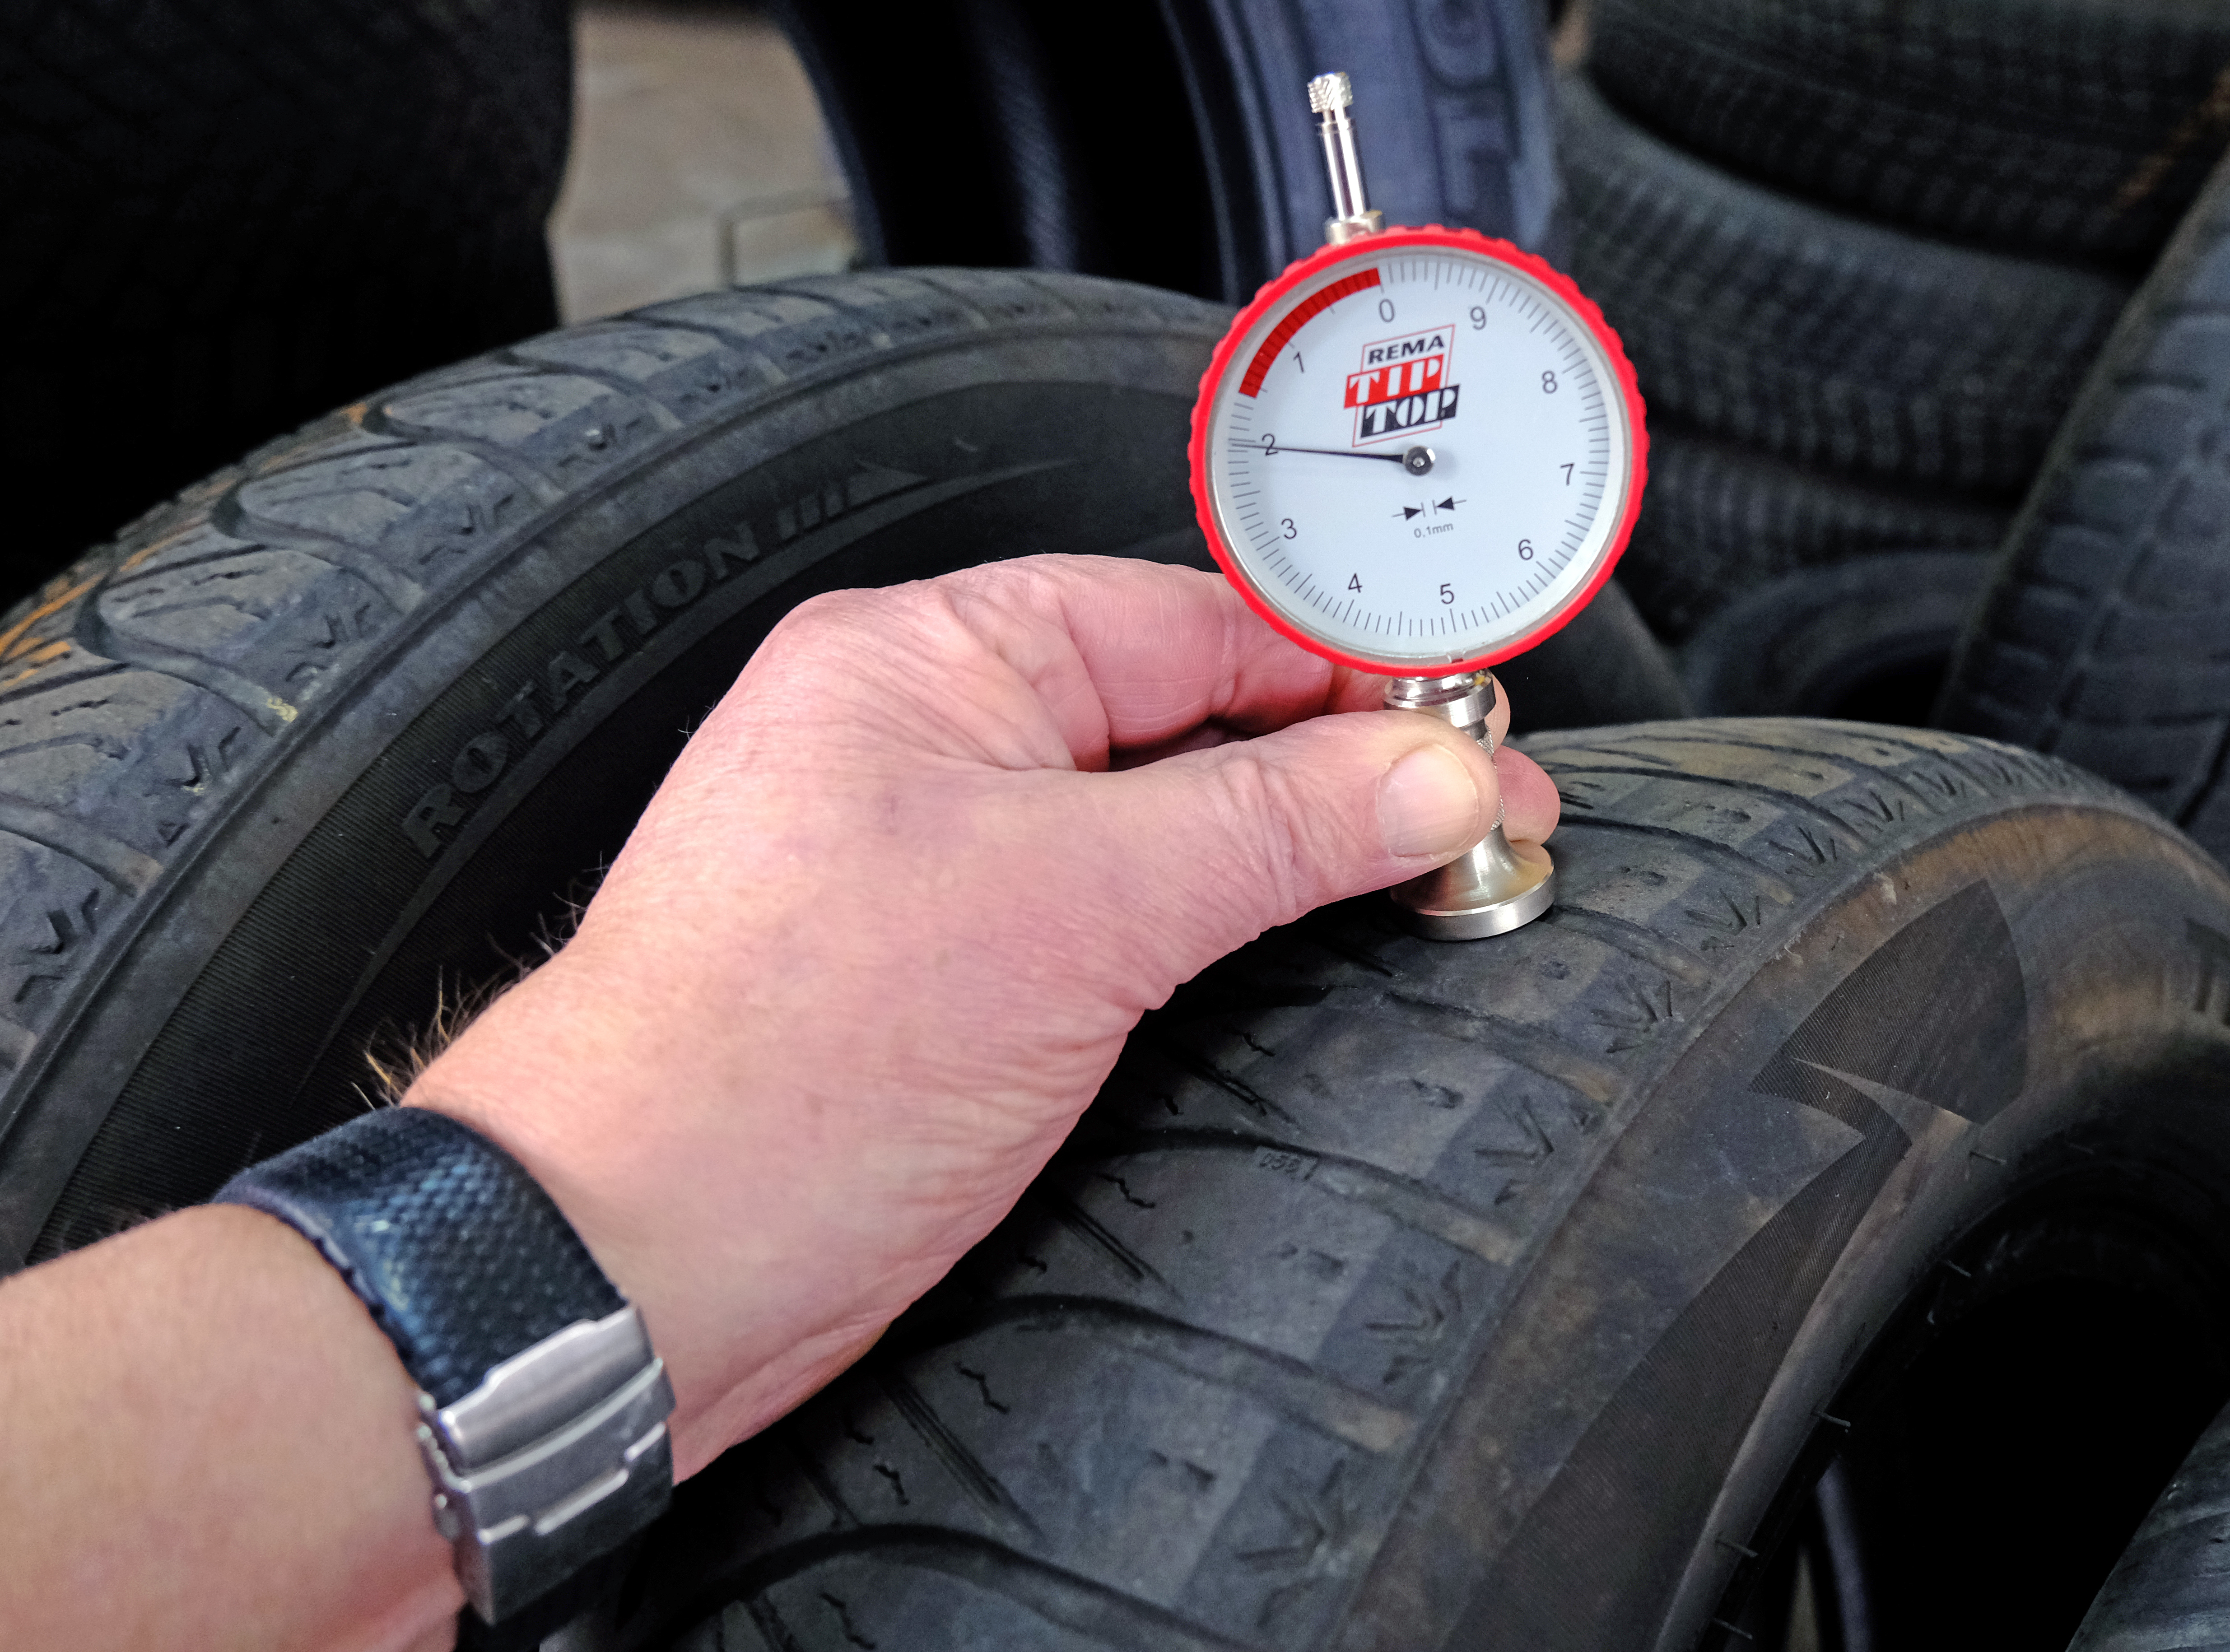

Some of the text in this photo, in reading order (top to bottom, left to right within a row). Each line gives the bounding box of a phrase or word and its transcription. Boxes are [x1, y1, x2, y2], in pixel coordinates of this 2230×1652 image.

[1378, 299, 1395, 323] 0
[1470, 306, 1487, 331] 9
[1368, 335, 1445, 365] REMA
[1293, 351, 1305, 374] 1
[1349, 358, 1441, 405] TIP
[1541, 370, 1558, 395] 8
[1364, 388, 1456, 434] TOP
[1262, 433, 1278, 456] 2
[1559, 462, 1575, 486] 7
[1281, 518, 1298, 540] 3
[1518, 538, 1534, 561] 6
[1347, 572, 1363, 594] 4
[1440, 582, 1455, 605] 5
[401, 520, 760, 858] ROTATION
